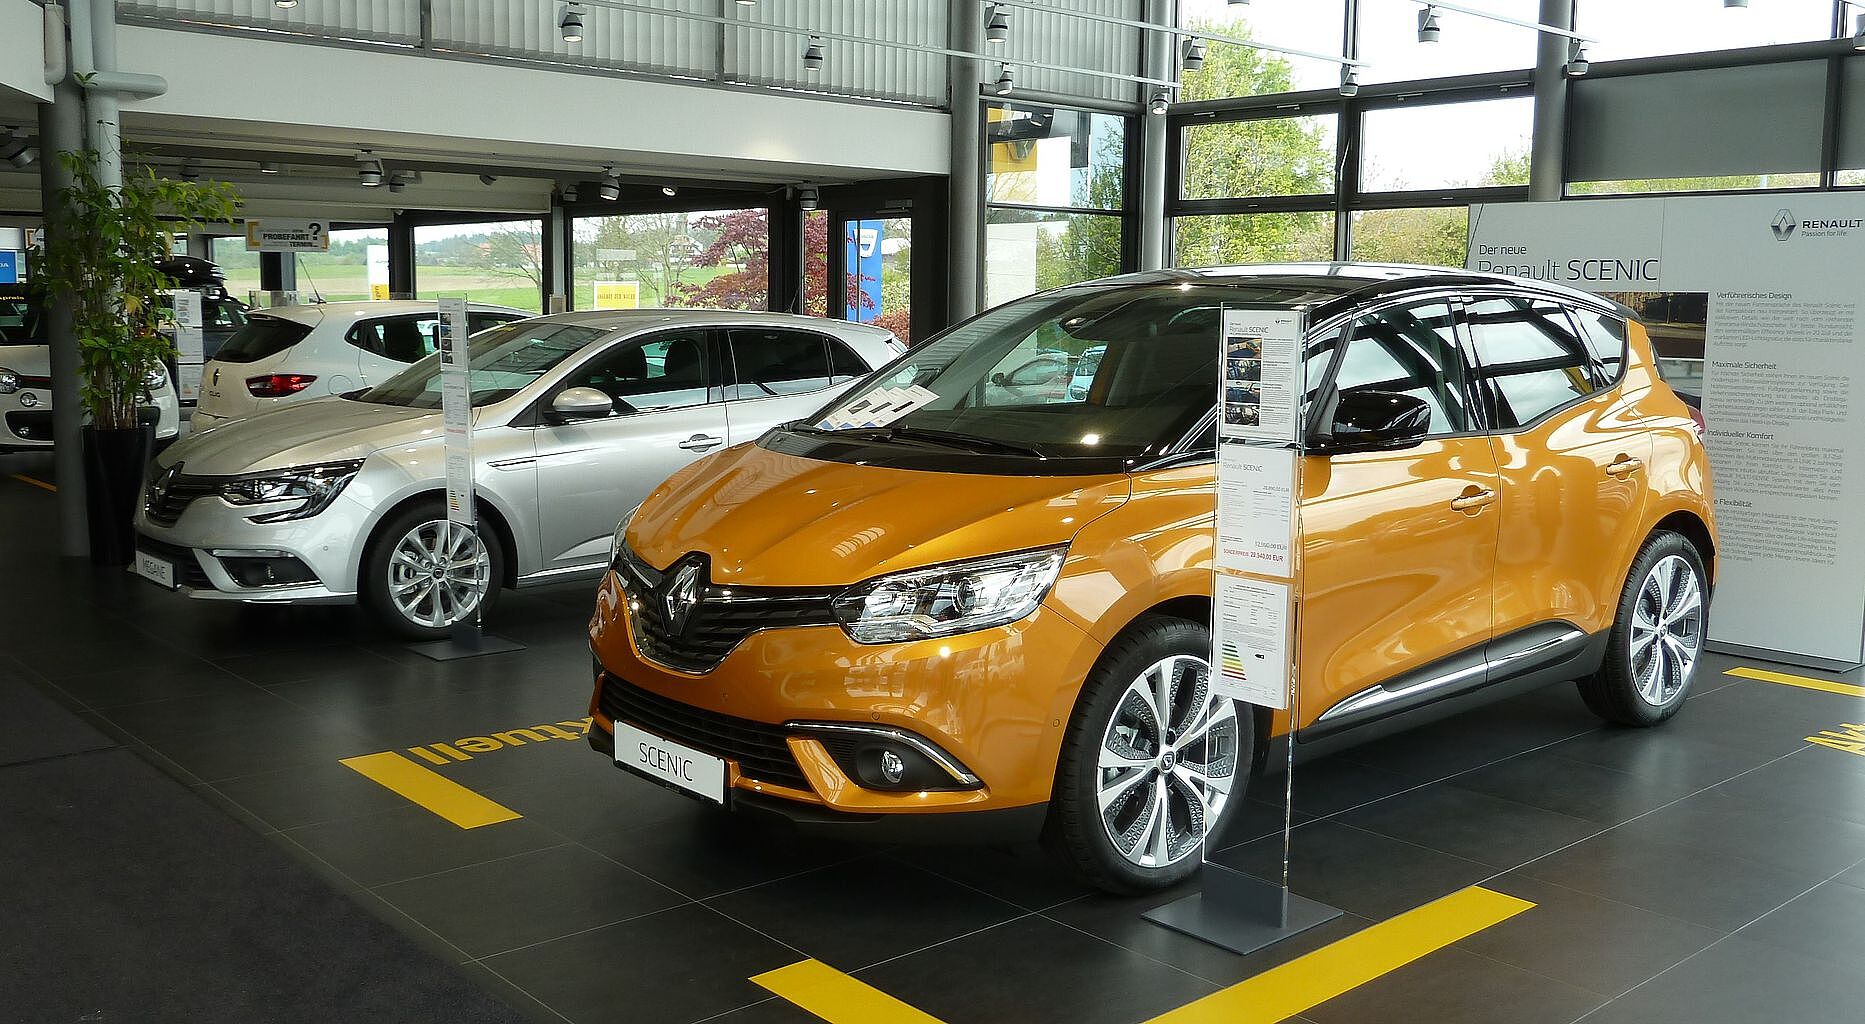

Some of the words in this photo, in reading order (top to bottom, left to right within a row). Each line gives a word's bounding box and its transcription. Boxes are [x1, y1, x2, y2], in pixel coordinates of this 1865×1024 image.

[1802, 219, 1863, 229] RENAULT
[263, 233, 309, 241] PROBEFAHRT
[1479, 244, 1498, 255] Der
[1500, 244, 1527, 255] neue
[1566, 259, 1659, 281] SCENIC
[1768, 292, 1792, 300] Design
[1712, 361, 1743, 369] Maximale
[1744, 362, 1777, 370] Sicherheit
[1707, 429, 1745, 438] Individueller
[1746, 431, 1774, 440] Komfort
[1719, 498, 1753, 508] Flexibilität
[638, 742, 693, 782] SCENIC
